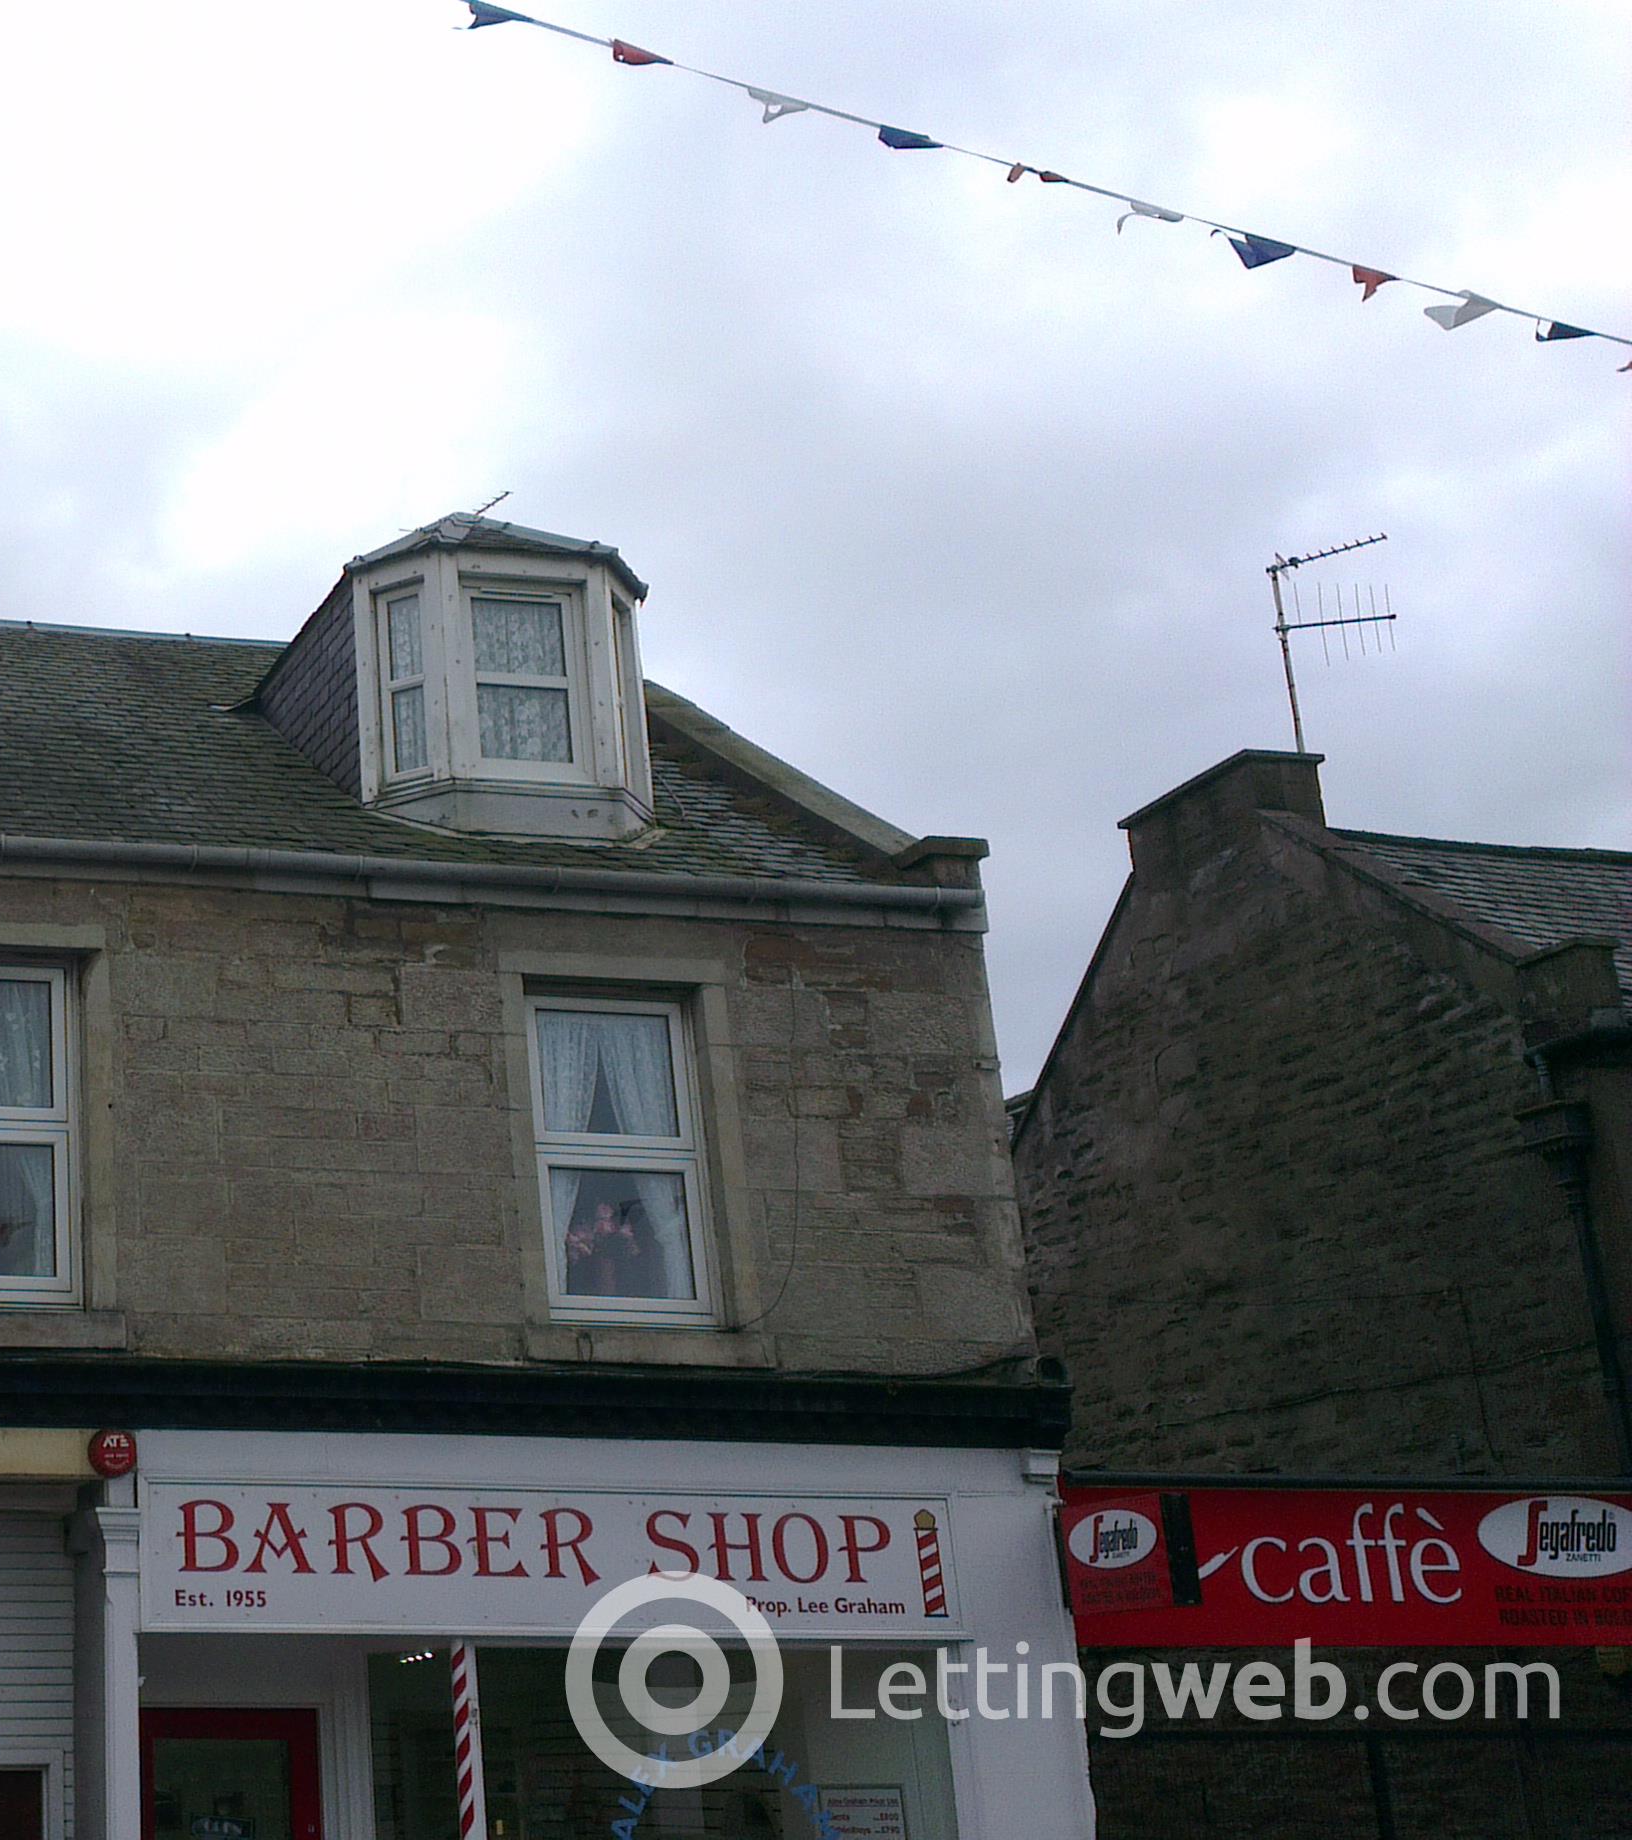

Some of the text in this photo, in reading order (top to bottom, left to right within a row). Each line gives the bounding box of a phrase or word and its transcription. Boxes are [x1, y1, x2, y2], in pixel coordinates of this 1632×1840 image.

[174, 1498, 893, 1588] BARBER SHOP
[1088, 1514, 1138, 1563] Segafredo
[1240, 1502, 1463, 1604] caffè
[1517, 1499, 1617, 1567] Segafredo
[1566, 1553, 1602, 1562] ZANETTI
[174, 1589, 268, 1608] Est. 1955
[745, 1596, 906, 1617] Prop. Lee Graham
